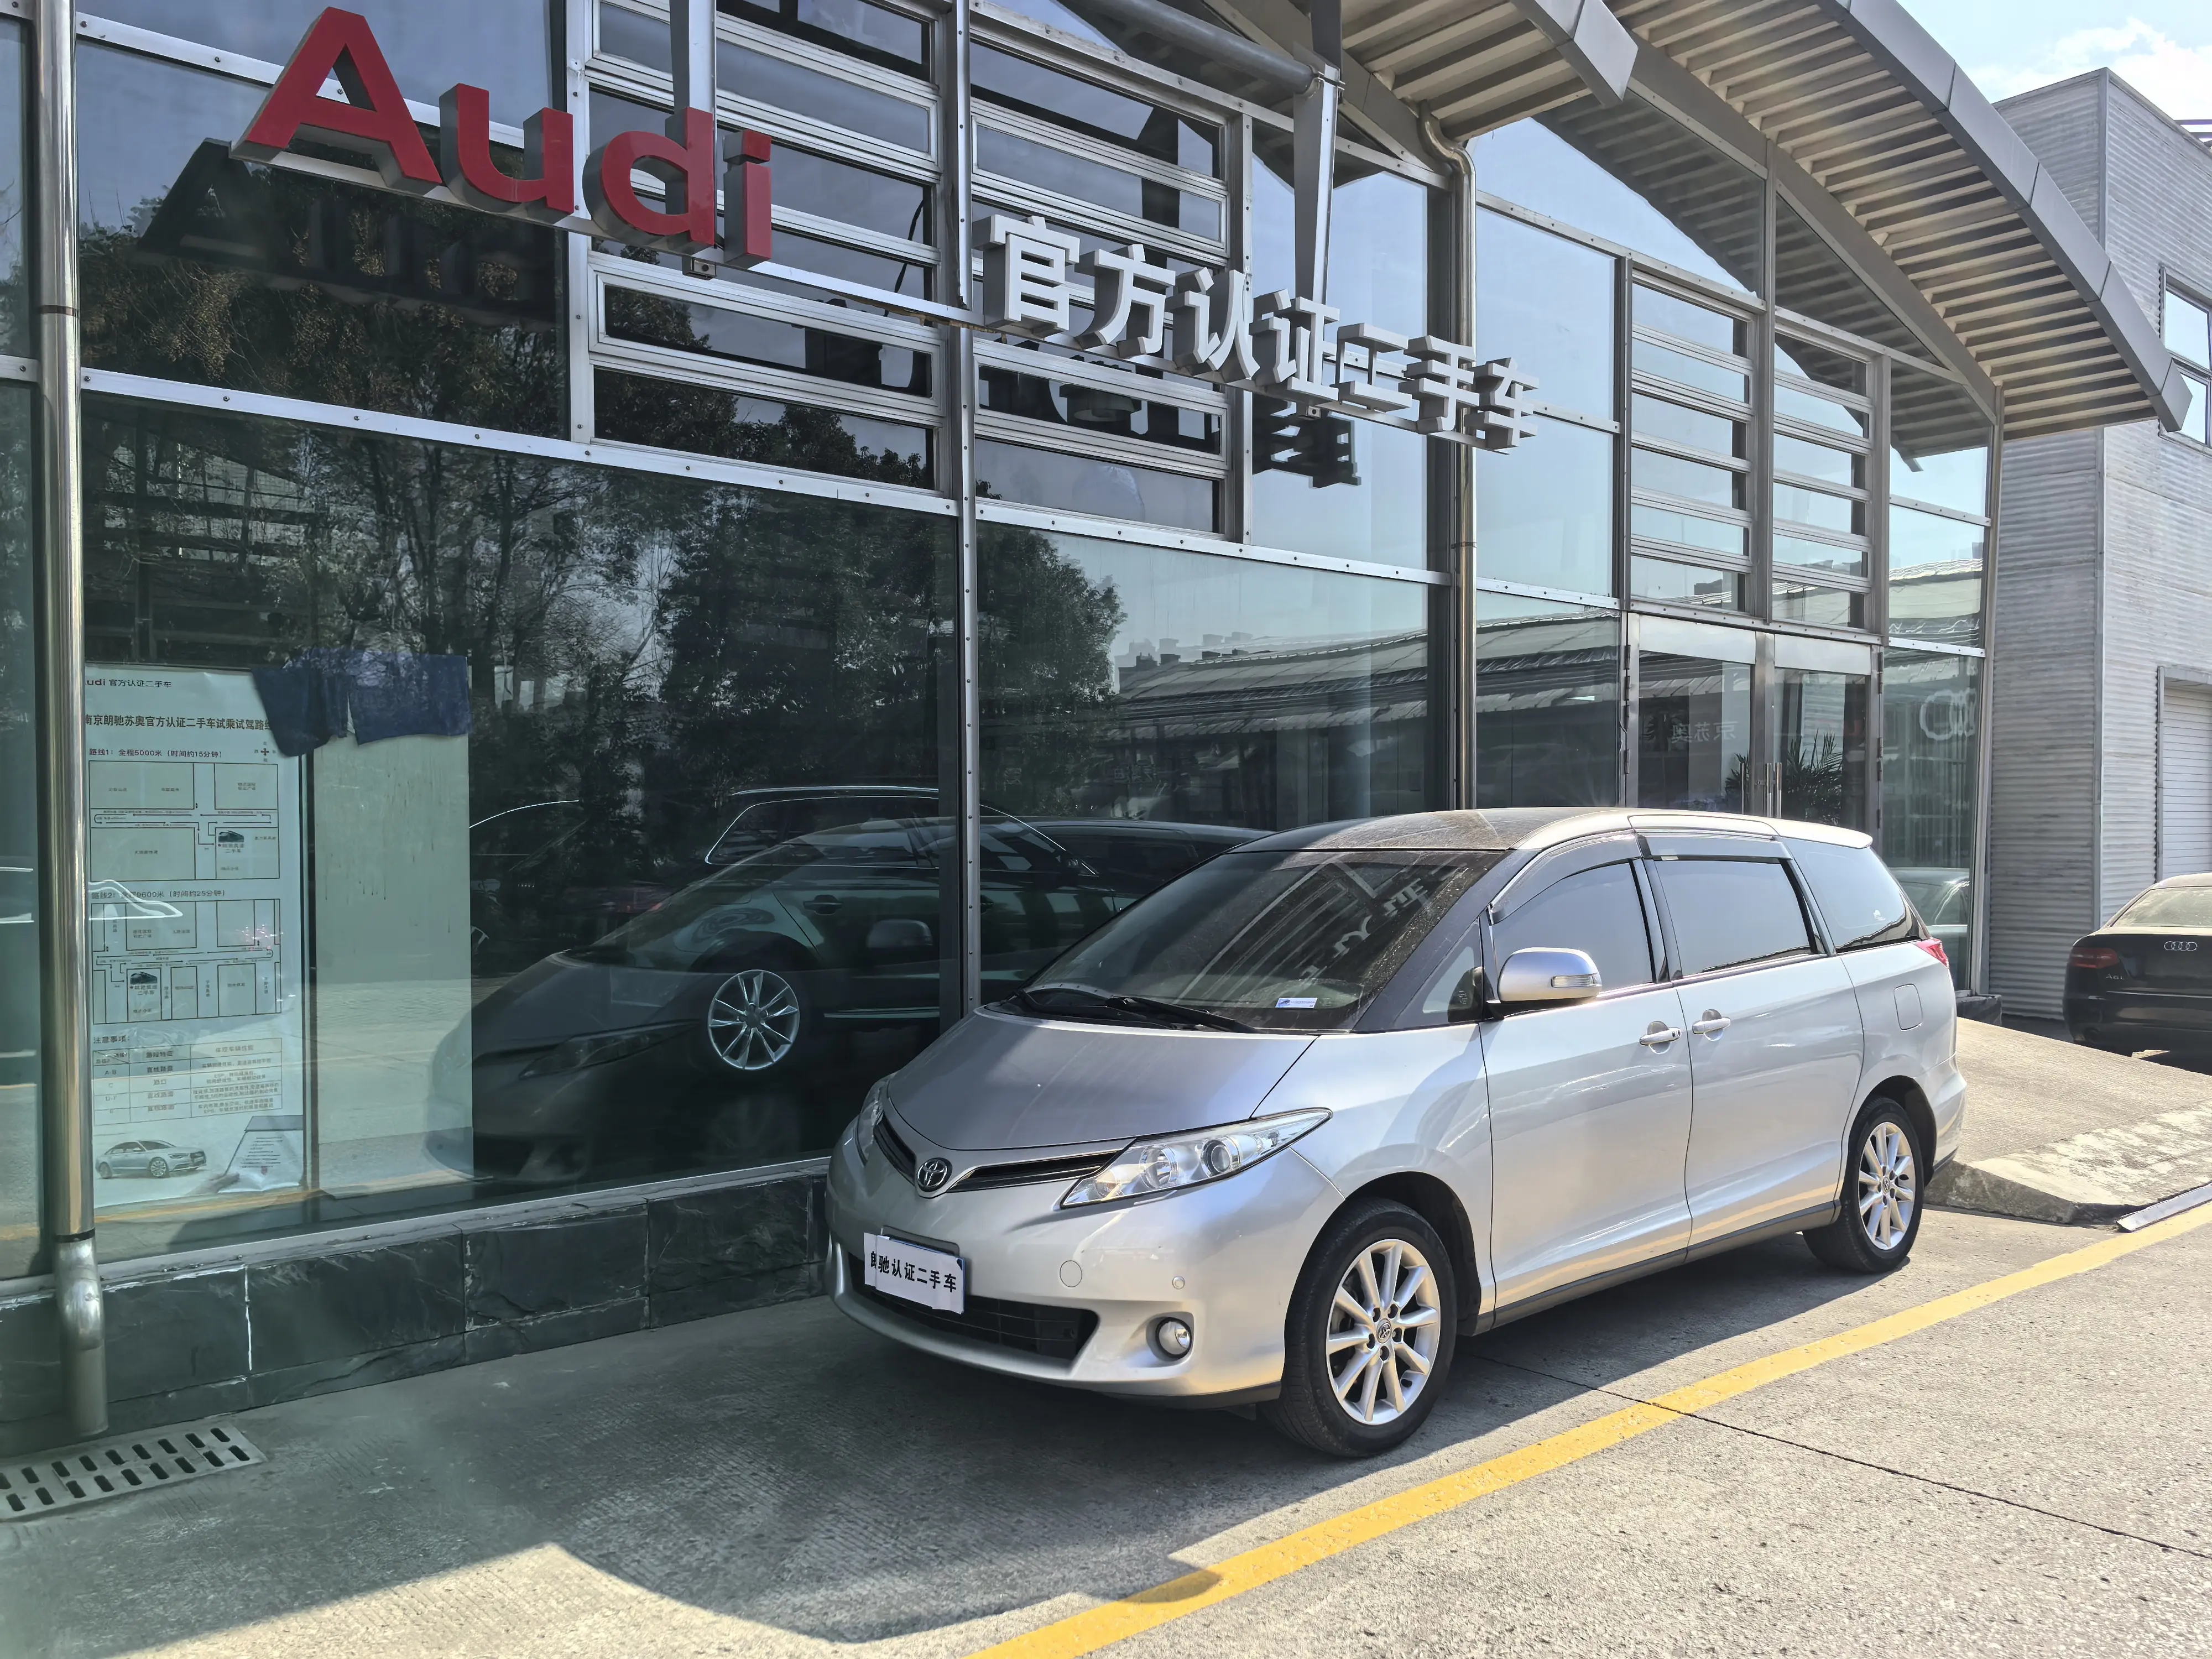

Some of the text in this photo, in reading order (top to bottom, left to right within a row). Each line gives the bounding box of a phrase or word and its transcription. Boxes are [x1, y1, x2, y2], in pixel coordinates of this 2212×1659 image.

[229, 7, 772, 265] Audi
[972, 215, 1540, 451] 官方认证二手车
[109, 679, 172, 688] 官方认证二手车
